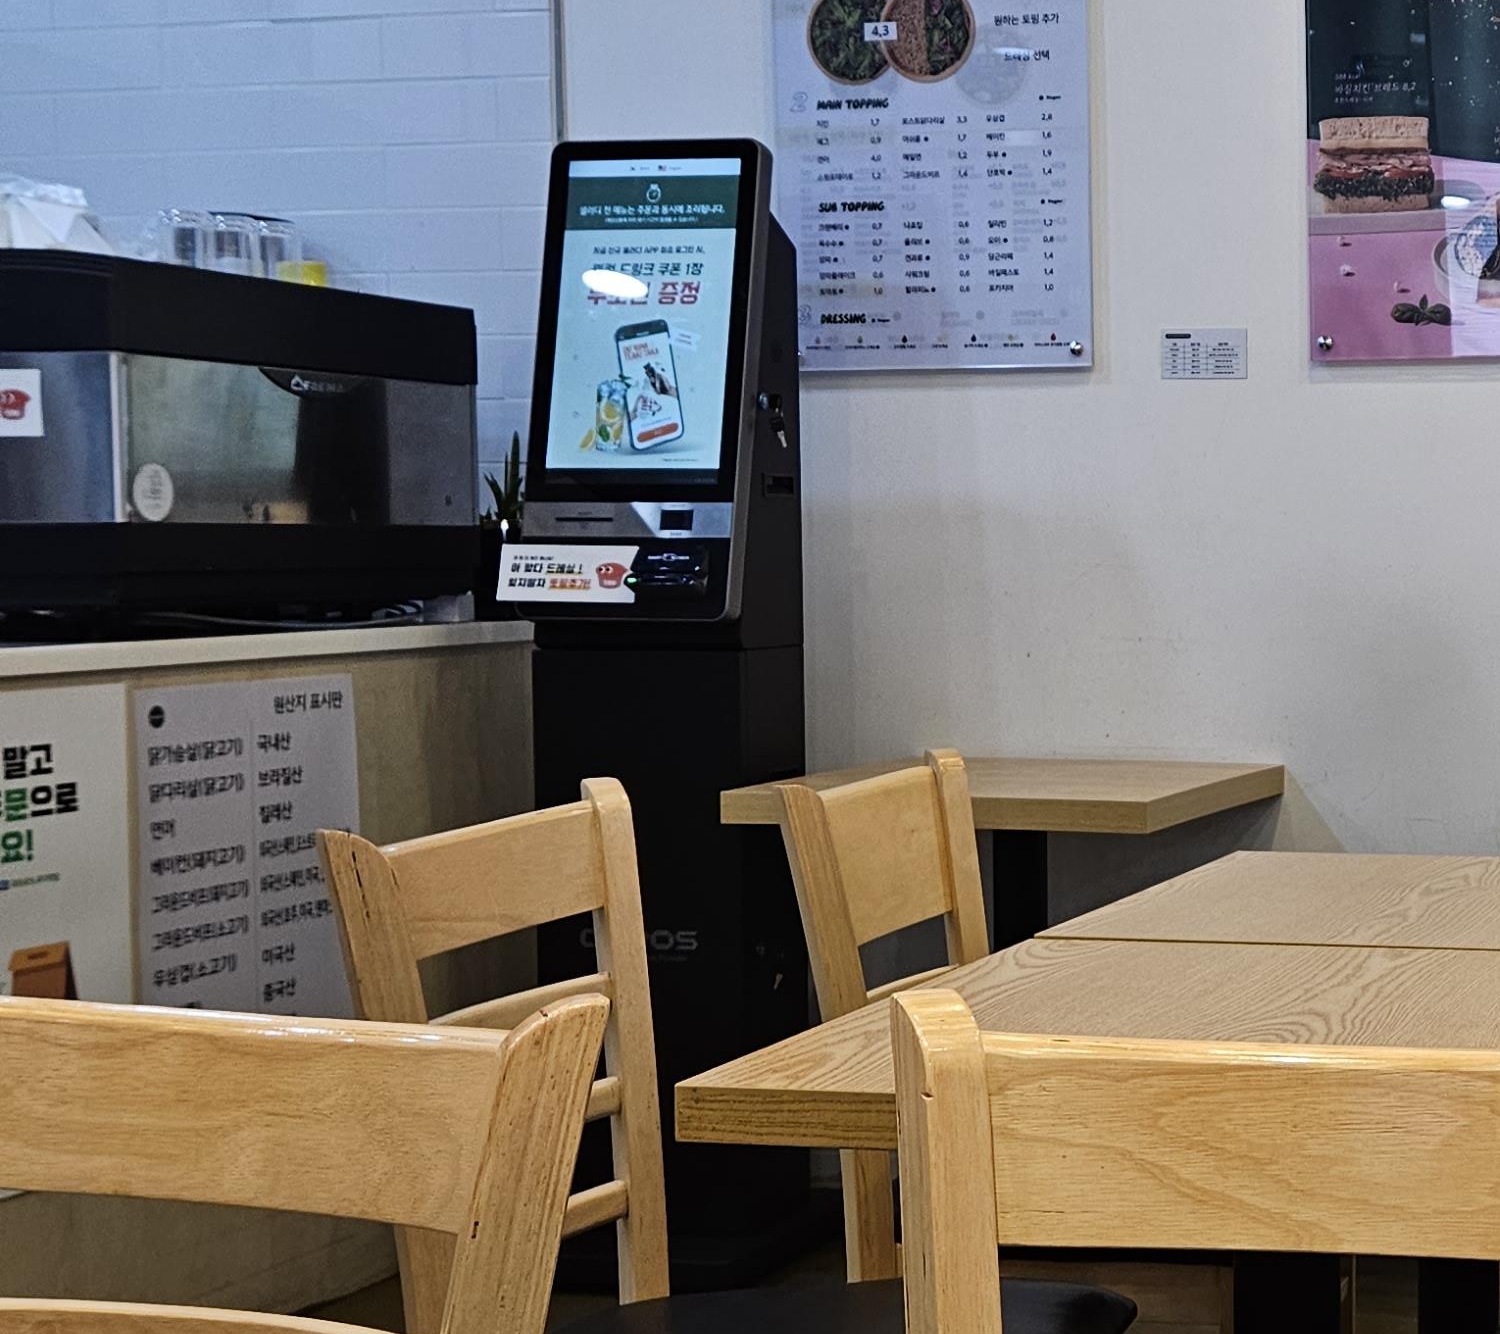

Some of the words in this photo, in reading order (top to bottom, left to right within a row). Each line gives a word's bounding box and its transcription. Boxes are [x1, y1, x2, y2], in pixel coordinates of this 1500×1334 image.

[1022, 14, 1039, 24] 토핑
[1042, 13, 1059, 24] 추가
[1033, 49, 1050, 61] 선택
[817, 100, 842, 110] MAIN
[845, 98, 889, 109] TOPPING
[819, 202, 837, 212] SUB
[841, 201, 884, 211] TOPPING
[658, 262, 682, 276] 쿠폰
[685, 262, 704, 275] 1장
[658, 282, 701, 305] 증정
[821, 313, 866, 324] DRESSING
[274, 694, 307, 714] 원산지
[310, 690, 343, 713] 표시판
[256, 732, 292, 753] 국내산
[3, 743, 54, 779] 말고
[258, 765, 303, 787] 브라질산
[0, 782, 79, 822] 문으로
[261, 942, 295, 965] 미국산
